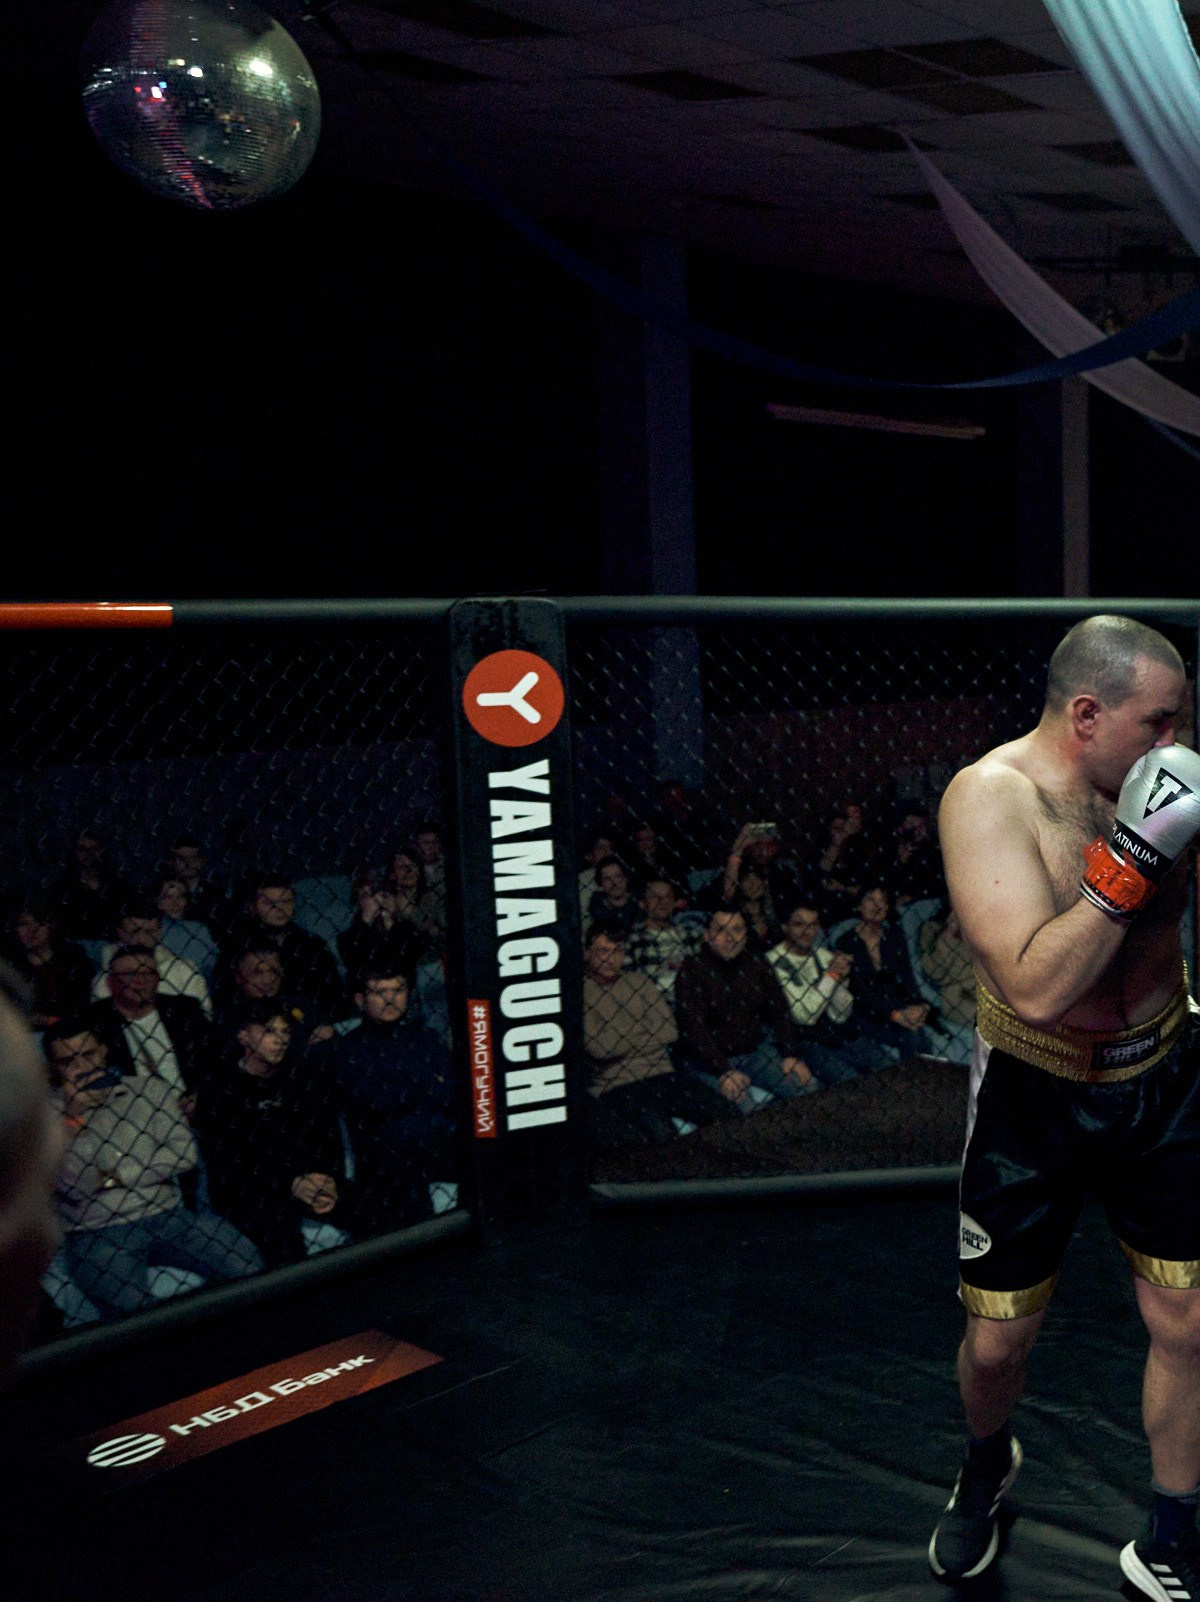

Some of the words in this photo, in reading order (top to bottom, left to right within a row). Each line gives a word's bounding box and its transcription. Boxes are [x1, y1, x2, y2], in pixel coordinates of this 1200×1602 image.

[488, 759, 568, 1131] YAMAGUCHI
[474, 1005, 493, 1132] #ЯМОГУЧИЙ
[962, 1227, 988, 1244] GREEN
[169, 1390, 276, 1436] НБД
[269, 1354, 375, 1396] Банк
